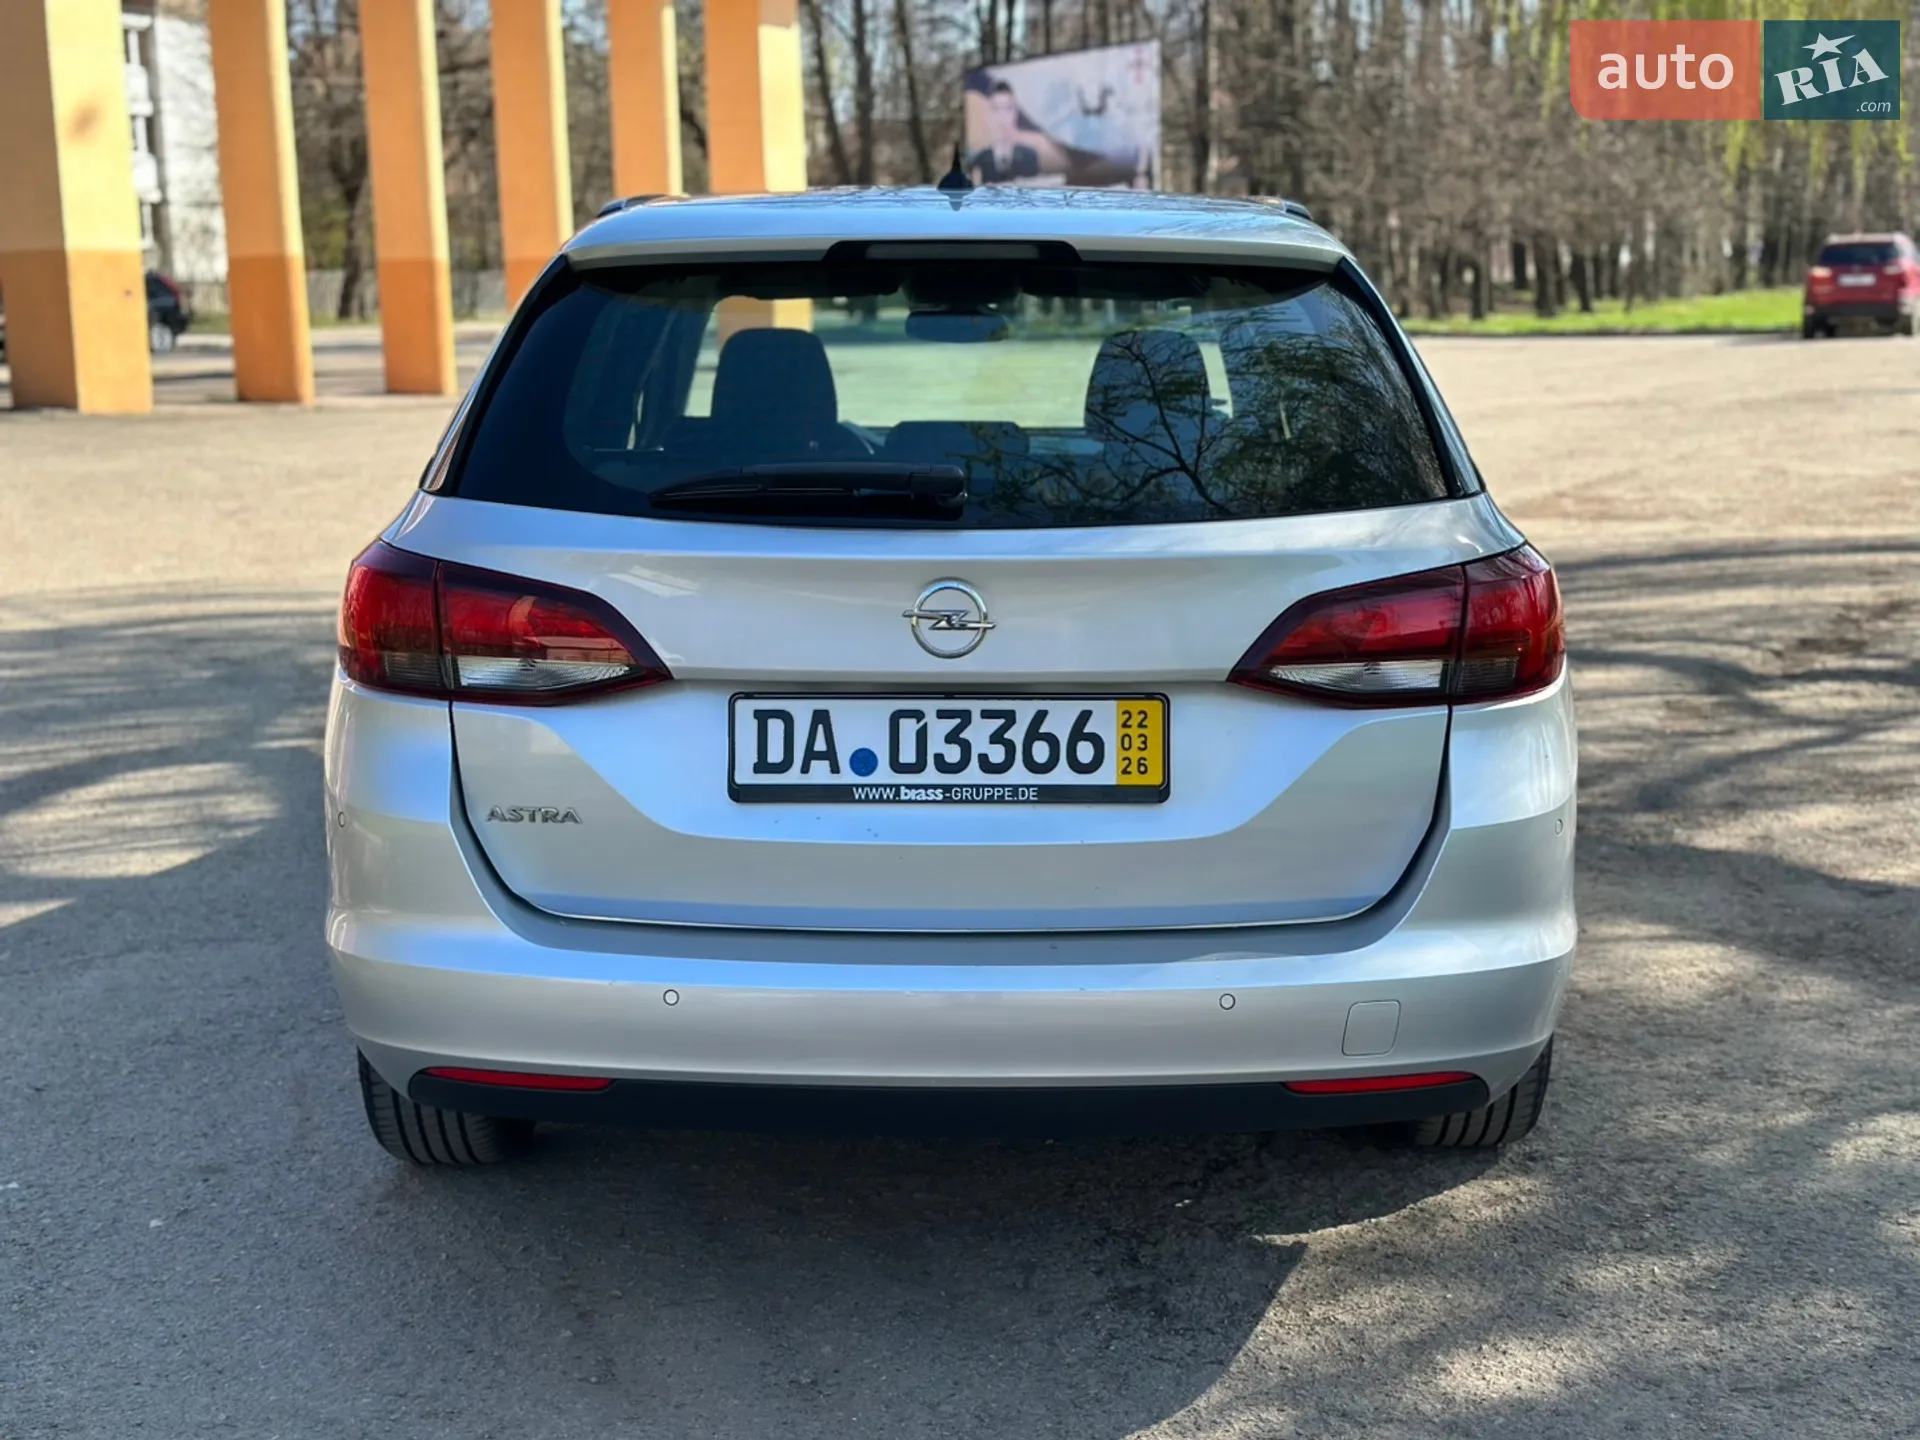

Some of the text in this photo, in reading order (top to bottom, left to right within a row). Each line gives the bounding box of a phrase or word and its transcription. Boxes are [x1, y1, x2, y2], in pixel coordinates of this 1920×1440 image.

[1121, 710, 1148, 729] 22
[752, 709, 1105, 775] DA 03366
[1121, 734, 1148, 752] 03
[1121, 757, 1148, 775] 26
[852, 785, 1038, 802] WWW.brass-GRUPPE.DE
[486, 805, 582, 824] ASTRA
